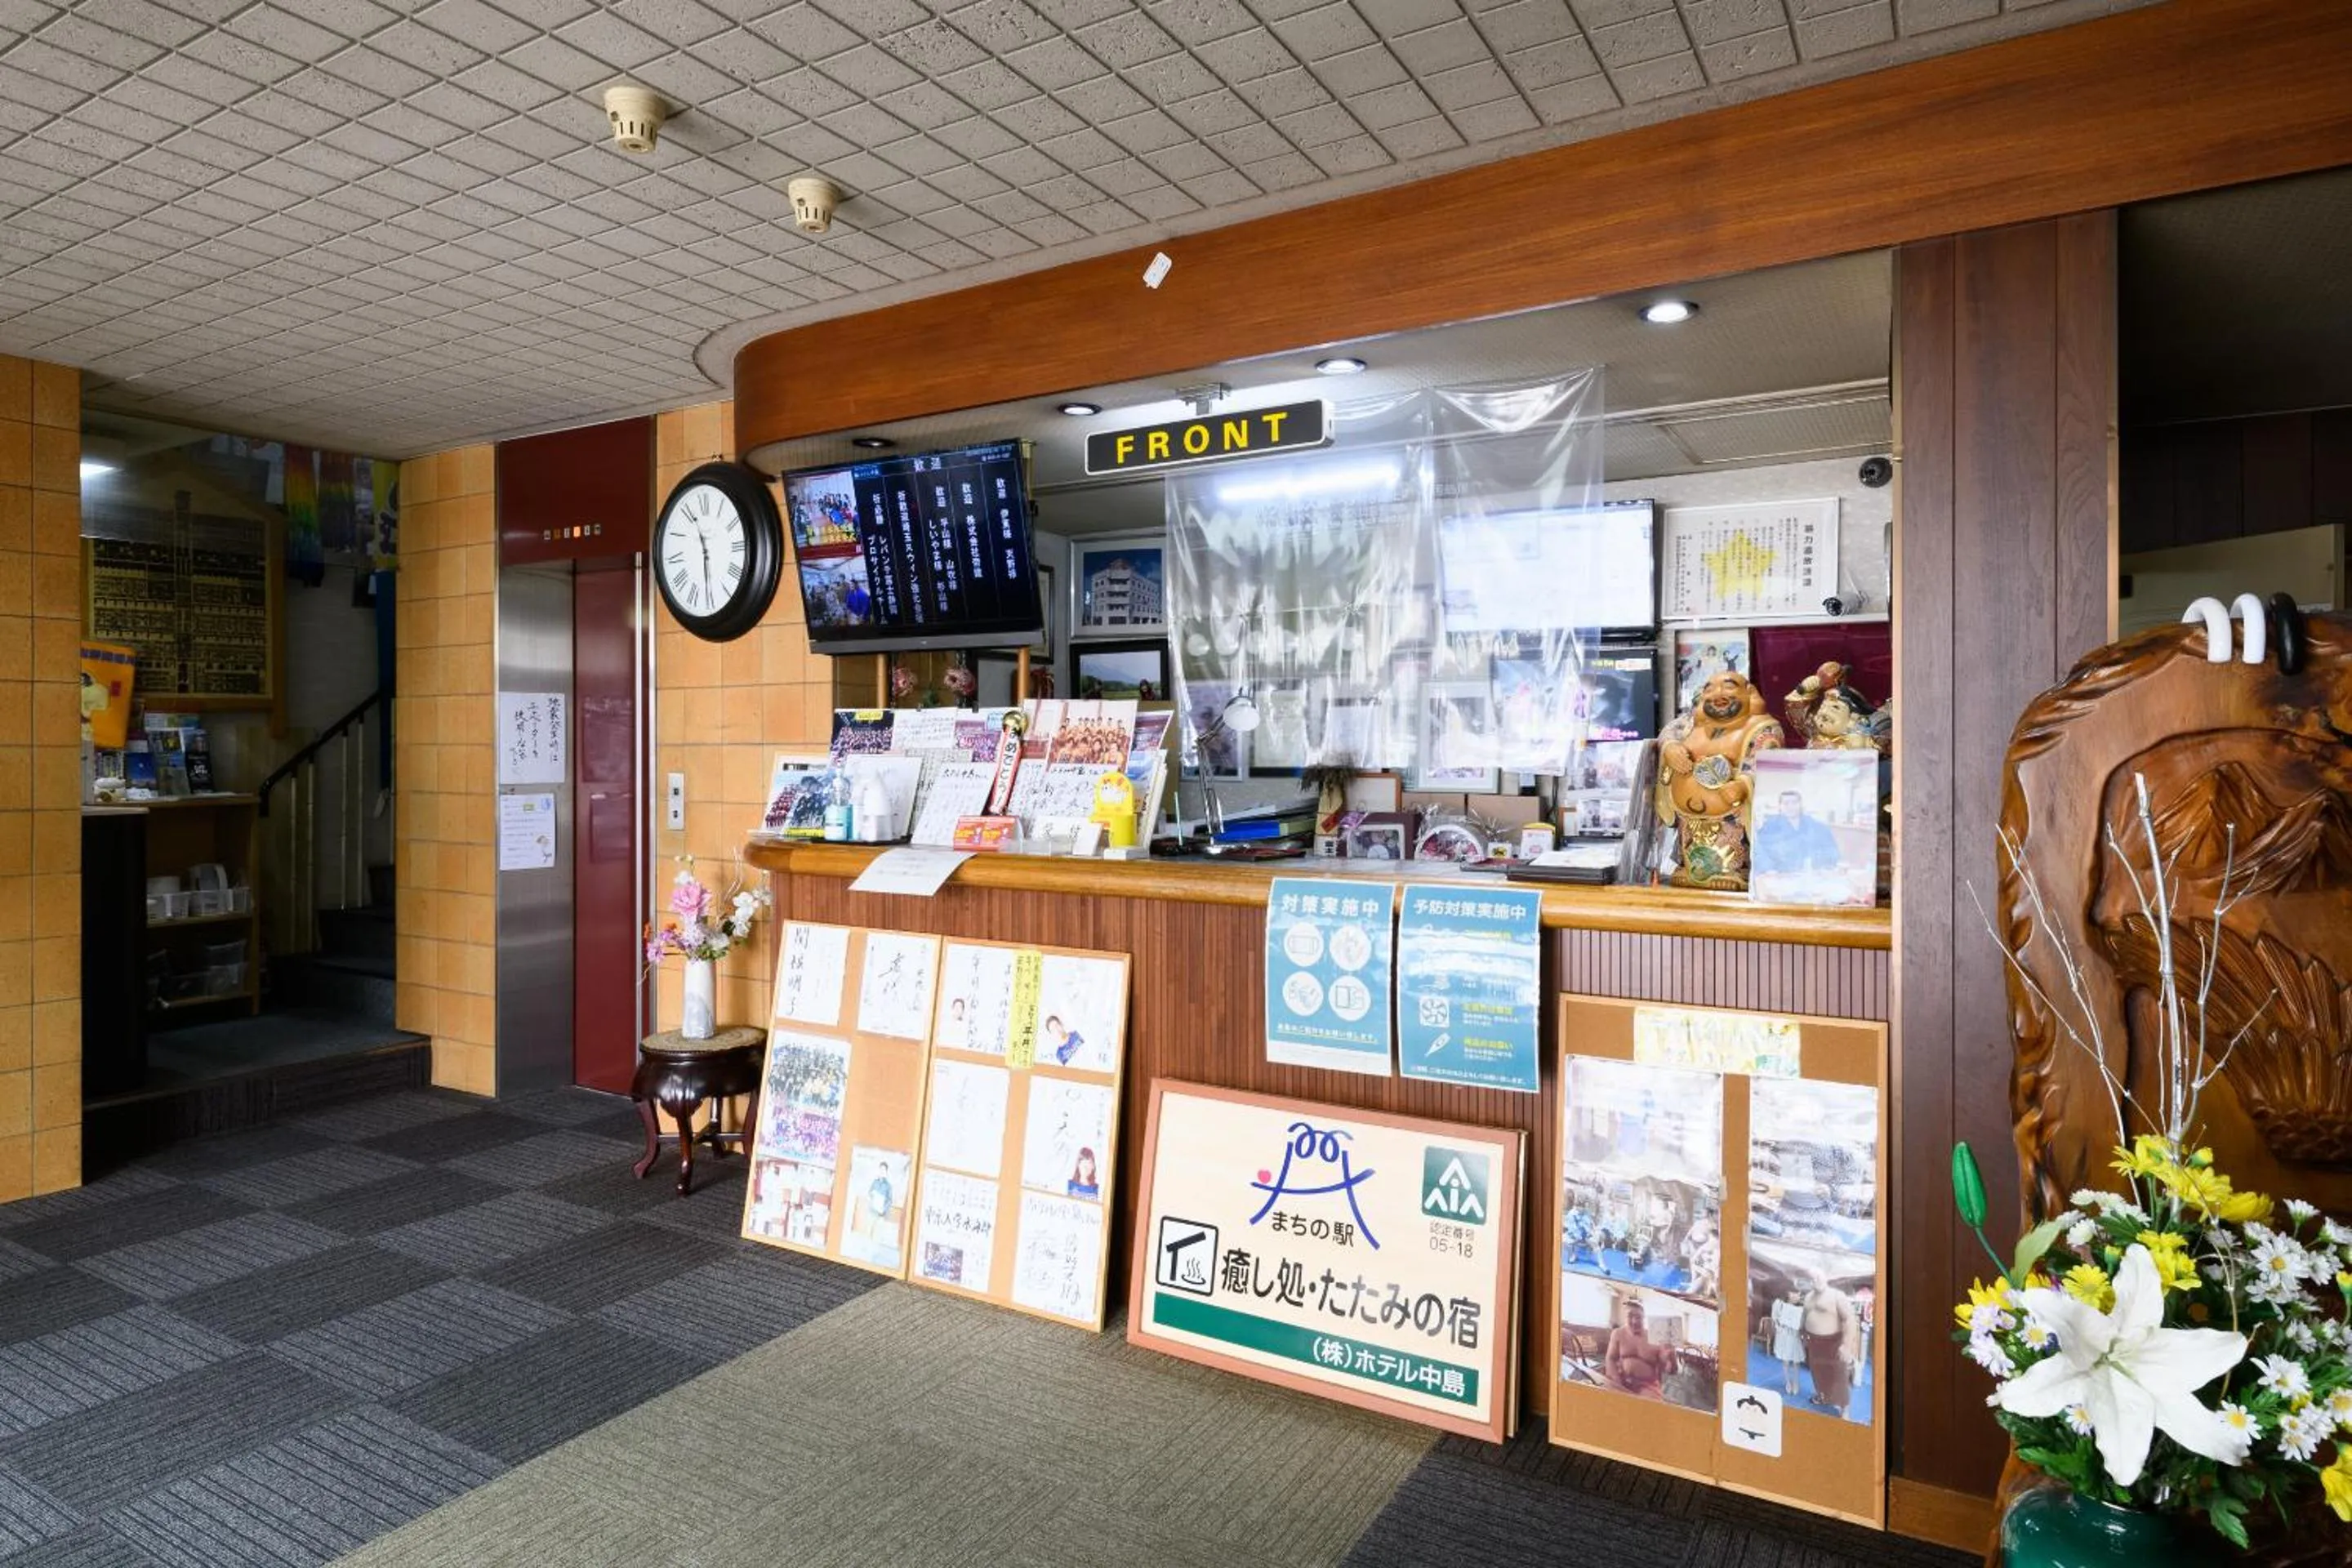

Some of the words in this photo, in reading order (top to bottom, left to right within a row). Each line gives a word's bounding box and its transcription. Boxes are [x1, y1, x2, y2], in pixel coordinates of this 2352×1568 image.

[1116, 411, 1288, 465] FRONT
[1281, 893, 1379, 918] 対策実施中
[1414, 898, 1526, 920] 予防対策実施中
[1272, 1210, 1355, 1248] まちの駅
[1429, 1220, 1475, 1241] 認定番号
[1221, 1246, 1481, 1350] 癒し処・たたみの宿
